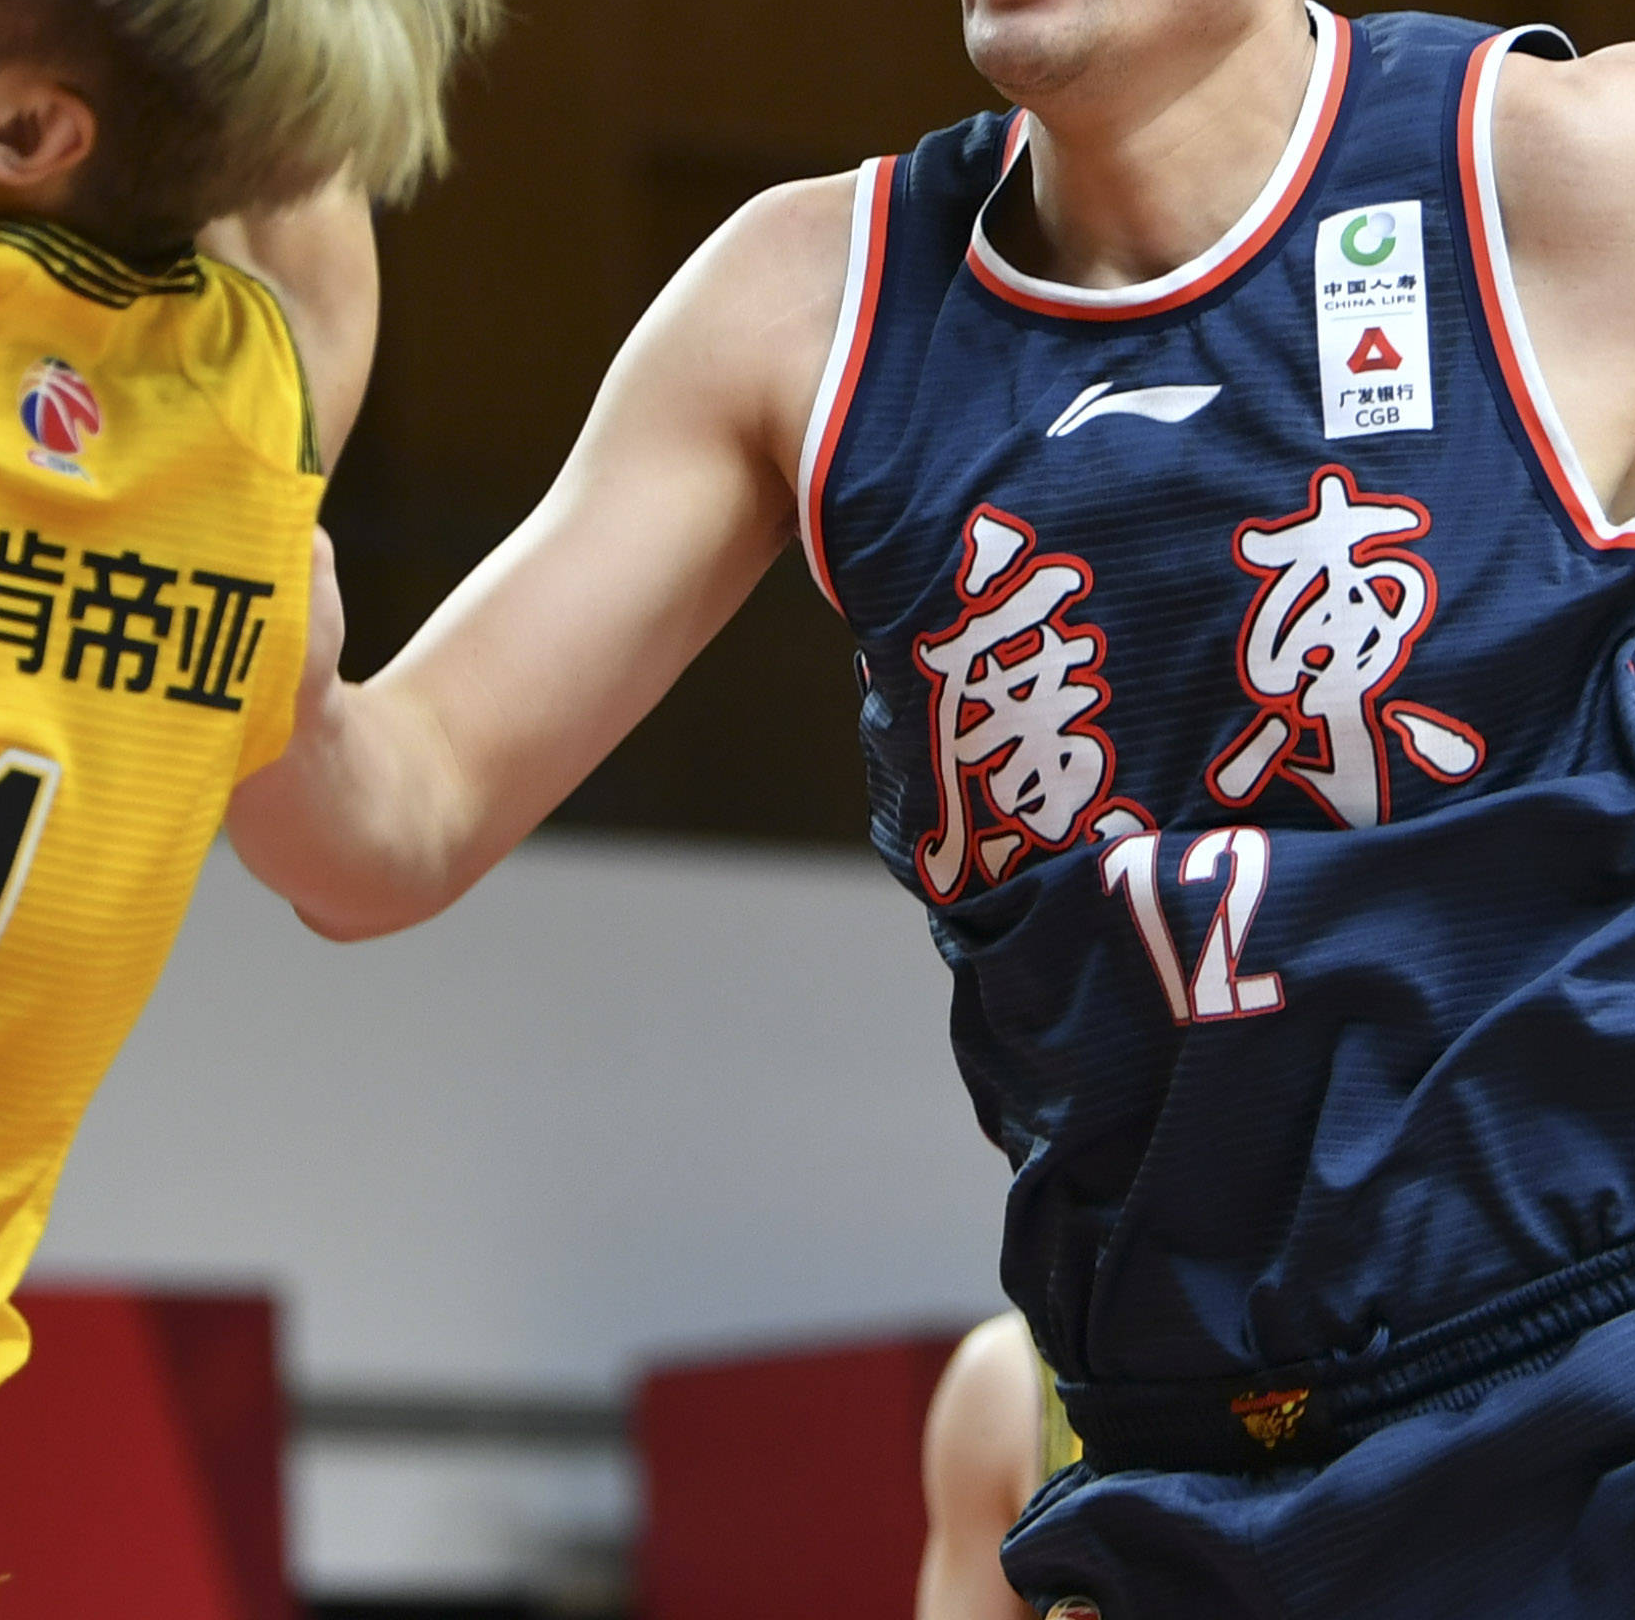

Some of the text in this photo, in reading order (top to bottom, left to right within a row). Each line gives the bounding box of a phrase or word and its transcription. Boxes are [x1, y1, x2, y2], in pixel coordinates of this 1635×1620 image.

[1323, 274, 1417, 298] 中国人寿
[1323, 294, 1417, 312] CHINA LIFE
[1339, 383, 1414, 409] 广发银行
[1354, 406, 1401, 428] CGB
[1098, 825, 1285, 1025] 12
